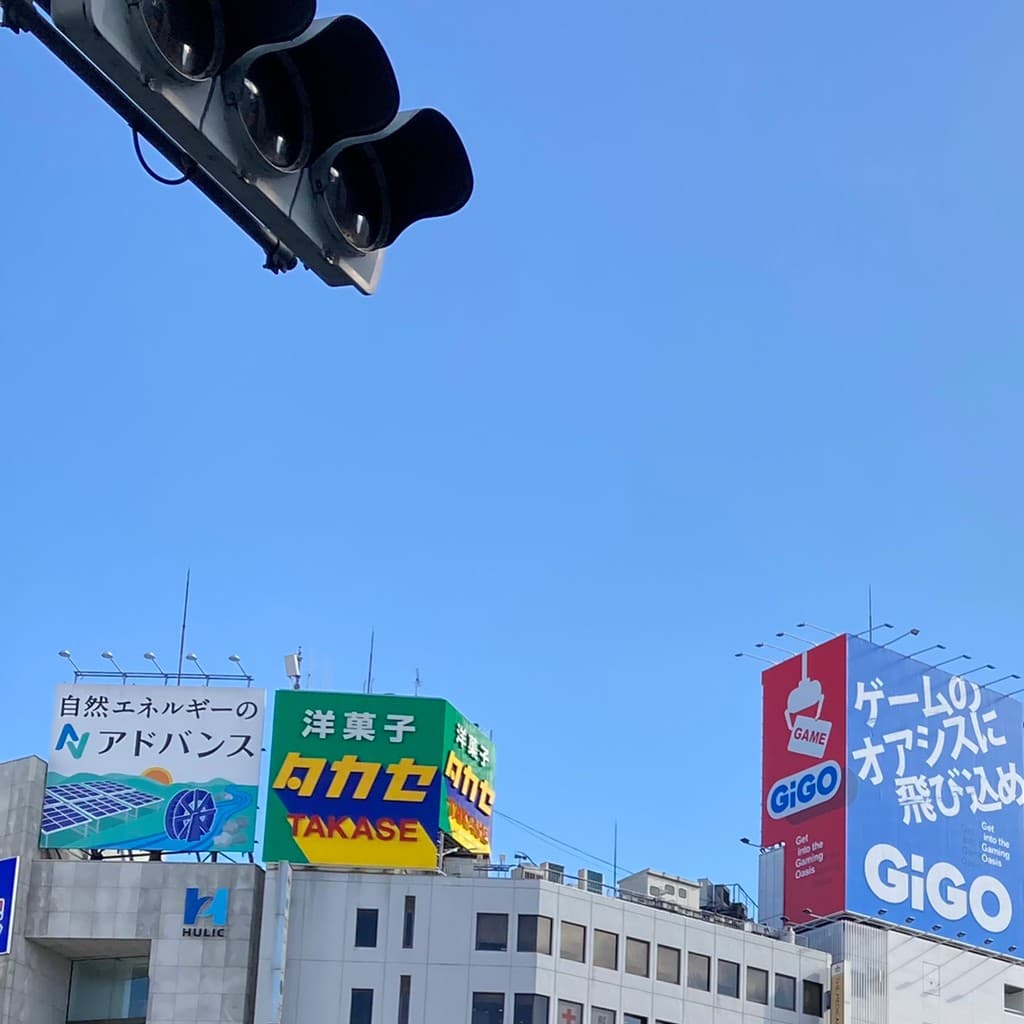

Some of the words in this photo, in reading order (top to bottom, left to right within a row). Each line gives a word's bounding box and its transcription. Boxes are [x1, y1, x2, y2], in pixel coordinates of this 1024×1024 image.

[59, 694, 258, 720] 自然エネルギーの
[853, 673, 982, 727] ゲームの
[302, 709, 417, 743] 洋菓子
[793, 726, 827, 746] GAME
[98, 729, 256, 759] アドバンス
[455, 722, 490, 765] 洋菓子
[852, 709, 1007, 786] オアシスに
[272, 751, 438, 803] タカセ
[444, 750, 495, 817] タカセ
[769, 764, 838, 815] GiGO
[894, 761, 1024, 826] 飛び込め
[287, 814, 418, 843] TAKASE
[448, 798, 490, 844] TAKASE
[981, 821, 994, 833] Get
[795, 834, 809, 845] Get
[811, 840, 824, 851] the
[981, 843, 1010, 861] Gaming
[998, 837, 1010, 848] the
[795, 853, 824, 868] Gaming
[795, 866, 816, 879] Oasis
[981, 853, 1003, 867] Oasis
[864, 843, 1013, 933] GiGO
[182, 927, 226, 938] HULIC
